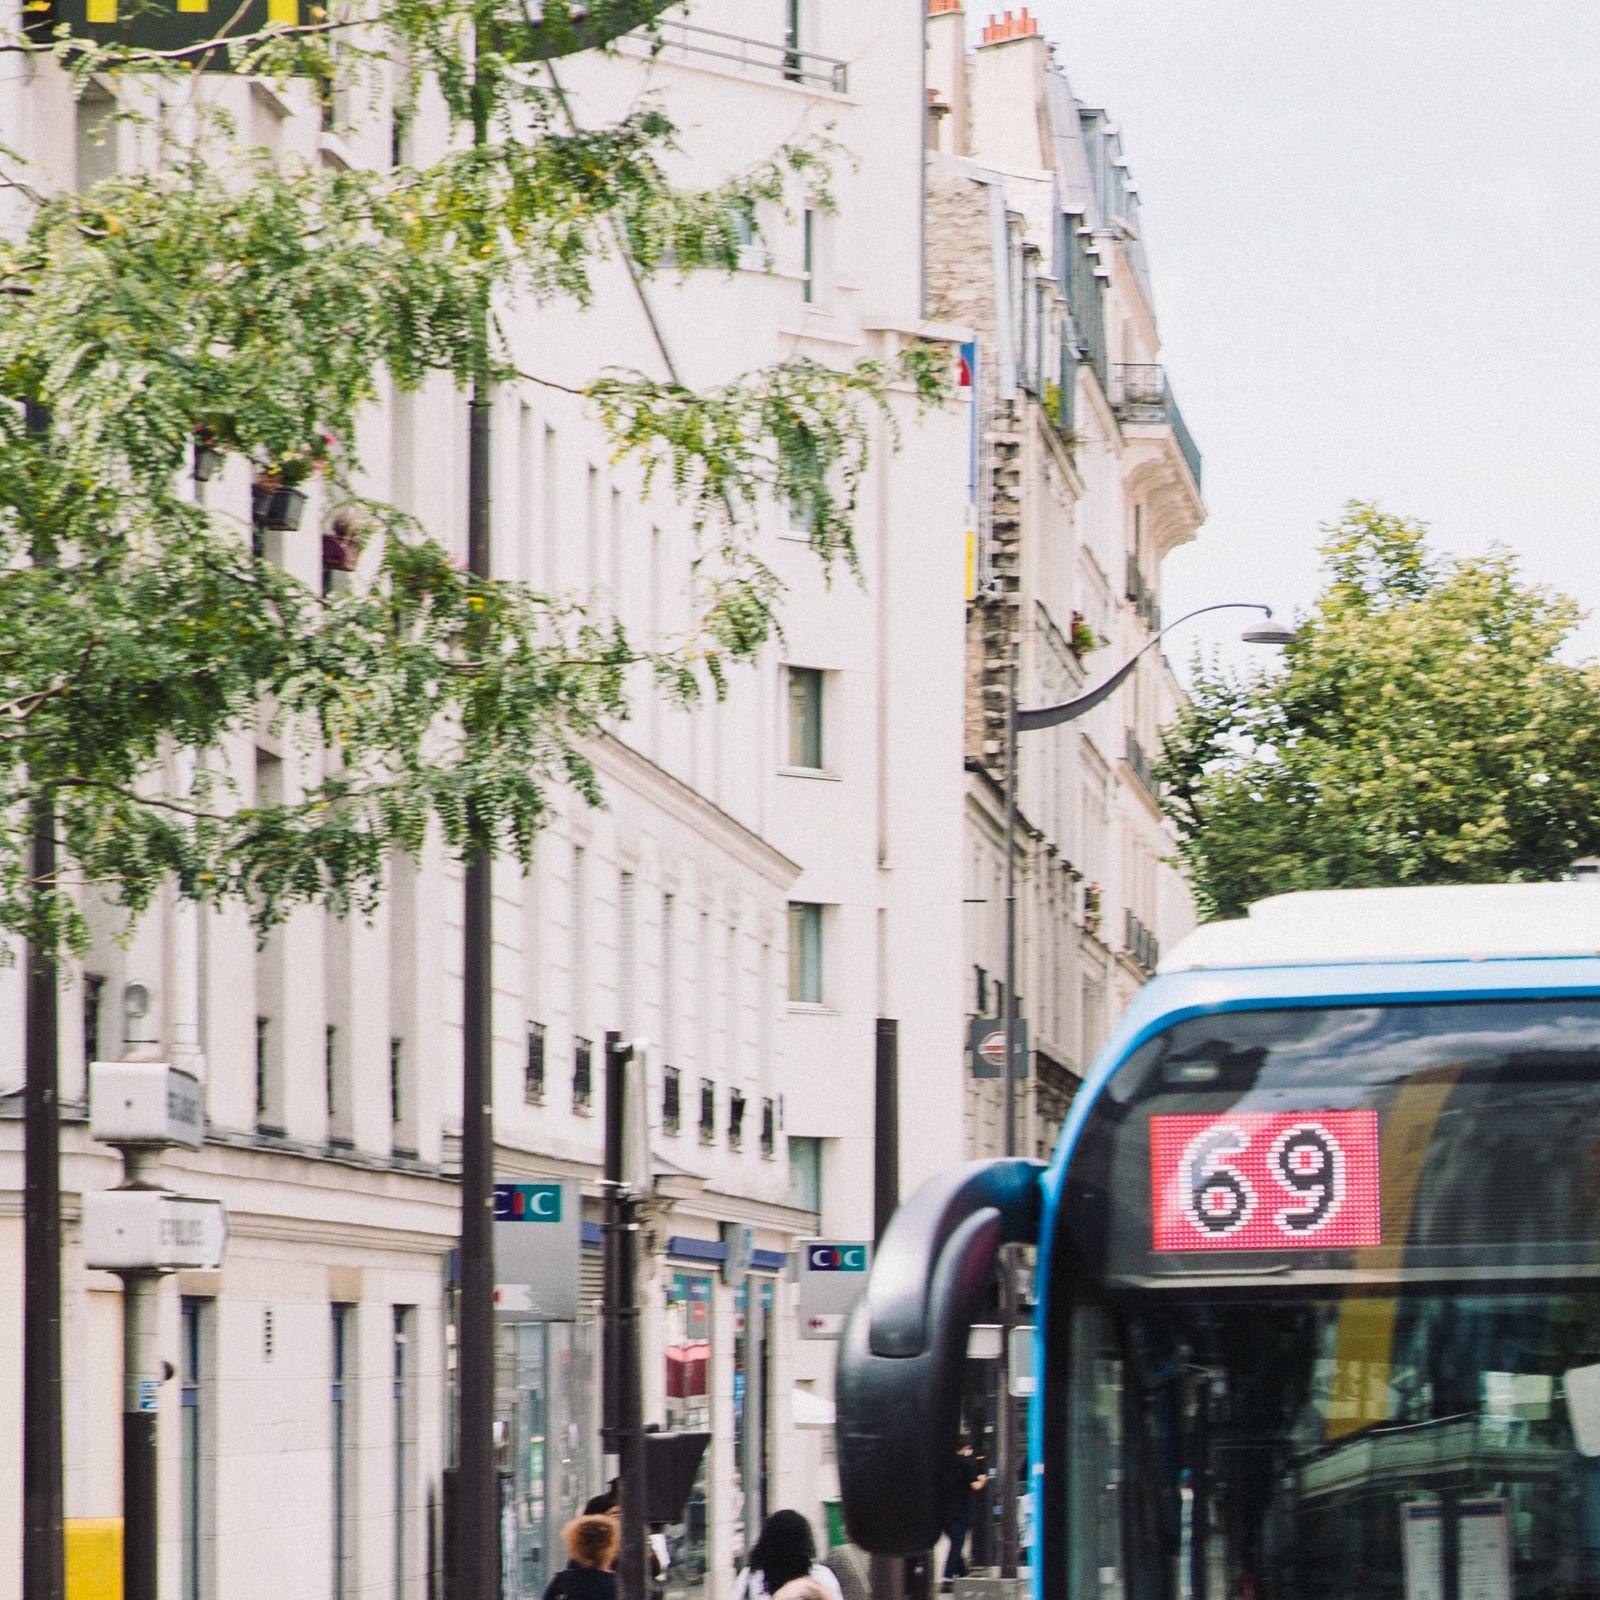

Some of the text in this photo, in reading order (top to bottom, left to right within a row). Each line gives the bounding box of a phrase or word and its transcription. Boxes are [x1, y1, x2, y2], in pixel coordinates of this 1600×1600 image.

[1178, 1120, 1348, 1238] 69
[492, 1191, 555, 1215] CIC
[812, 1249, 862, 1267] CIC
